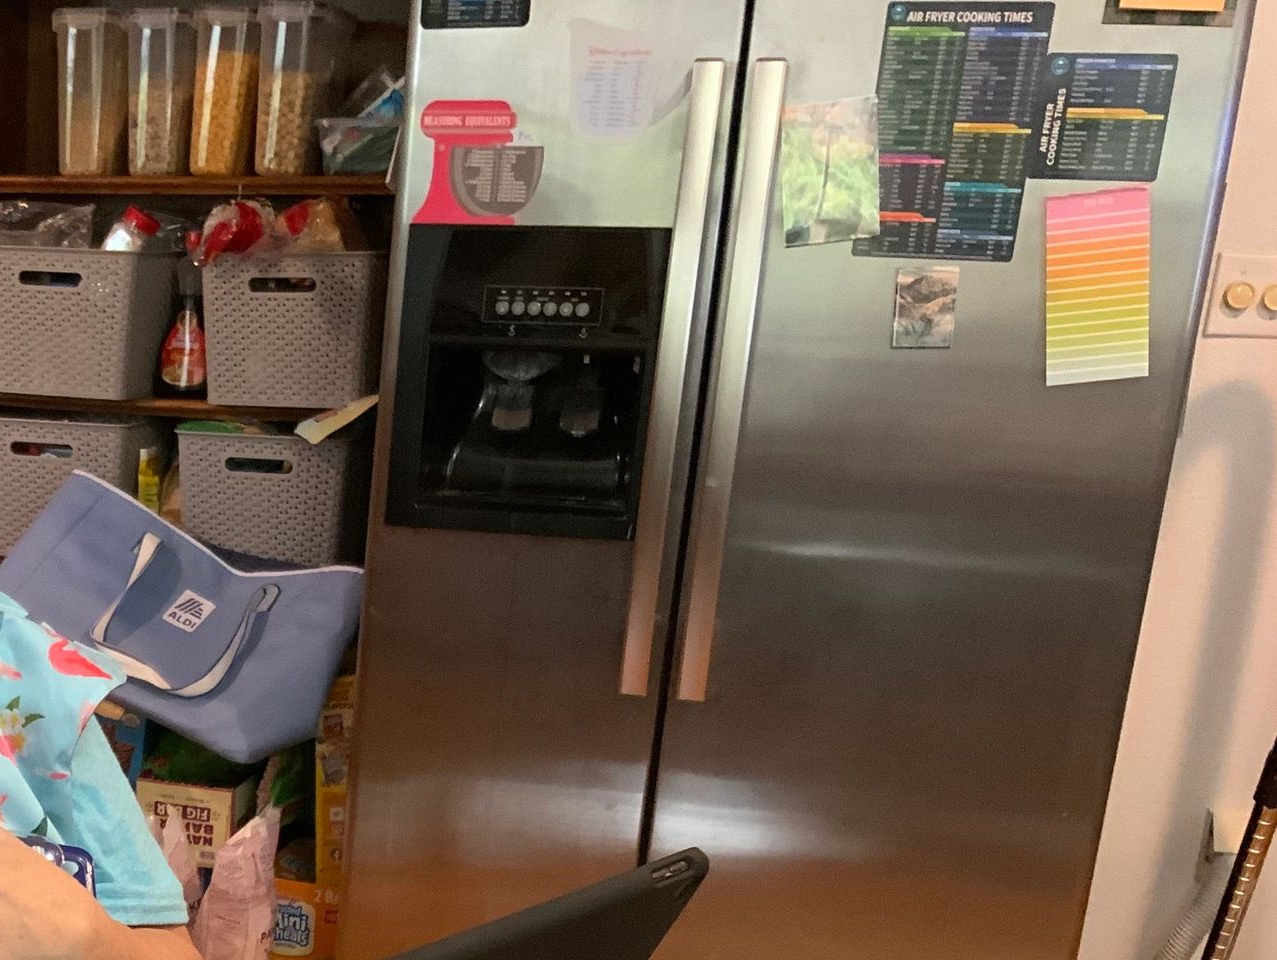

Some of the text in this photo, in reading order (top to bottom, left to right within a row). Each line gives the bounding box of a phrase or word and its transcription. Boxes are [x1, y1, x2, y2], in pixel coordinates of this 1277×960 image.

[907, 12, 1033, 23] AIR FRYER COOKING TIMES
[1040, 103, 1054, 152] AIR FRYER
[1046, 88, 1066, 165] COOKING TIMES
[168, 611, 197, 629] ALDI
[186, 808, 208, 820] FIG
